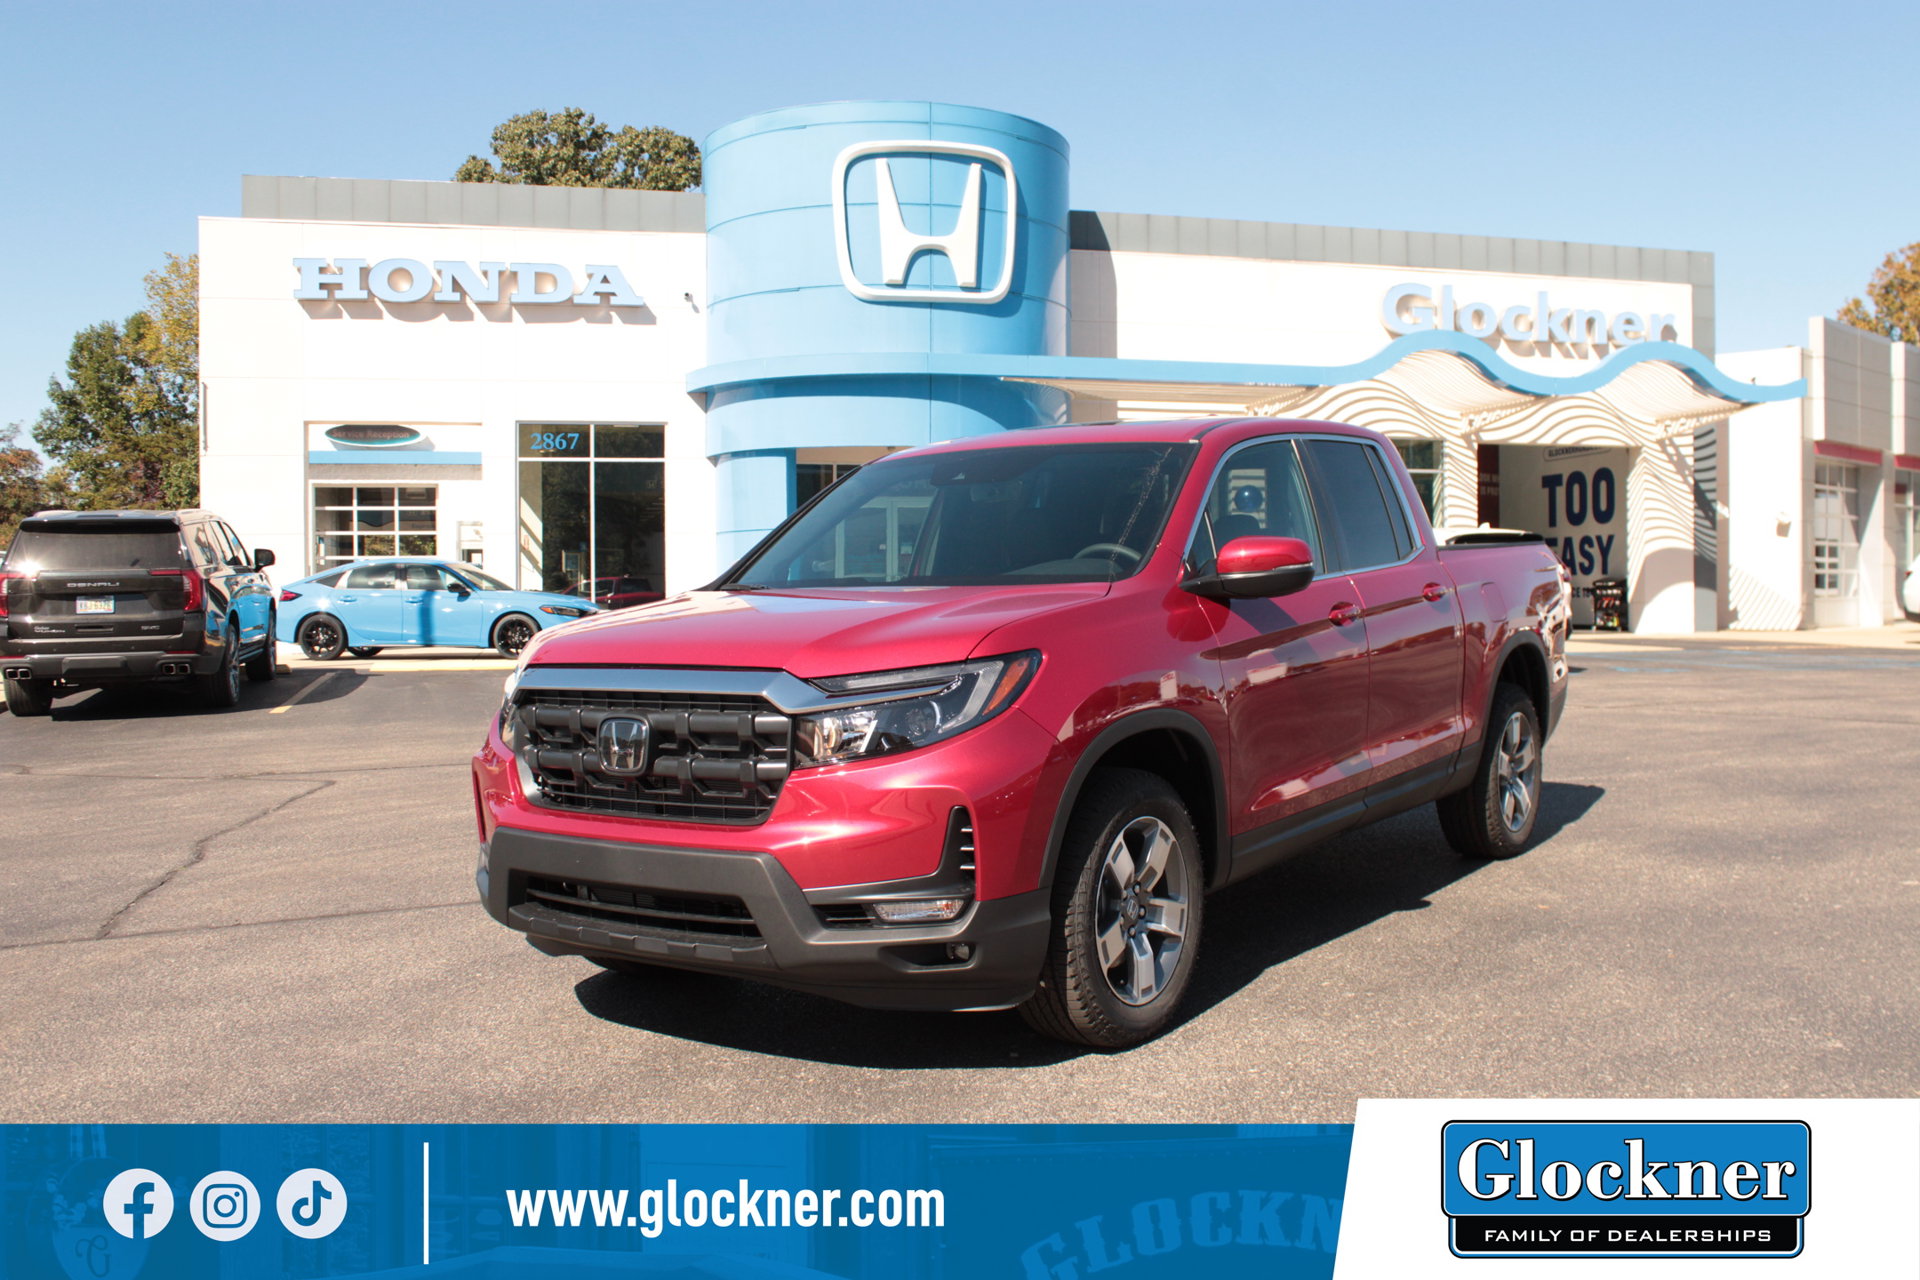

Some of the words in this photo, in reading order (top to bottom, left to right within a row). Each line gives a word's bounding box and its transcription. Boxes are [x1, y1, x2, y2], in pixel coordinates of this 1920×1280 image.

[293, 258, 644, 307] HONDA
[1382, 283, 1675, 346] Glockner
[530, 432, 580, 451] 2867
[1542, 467, 1615, 528] TOO
